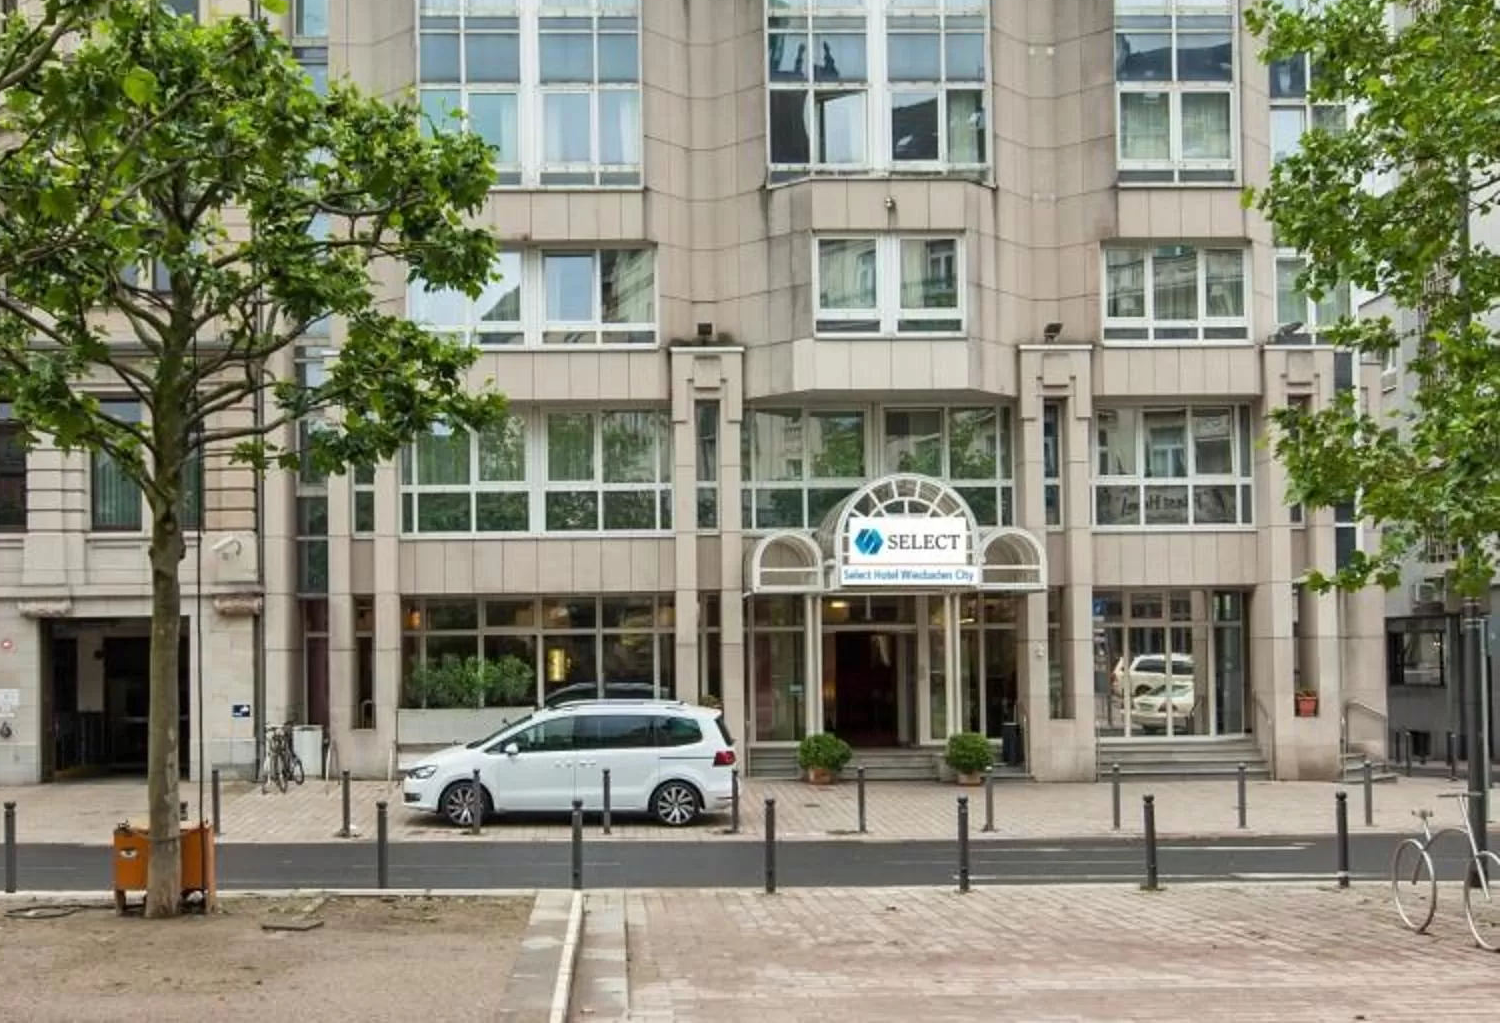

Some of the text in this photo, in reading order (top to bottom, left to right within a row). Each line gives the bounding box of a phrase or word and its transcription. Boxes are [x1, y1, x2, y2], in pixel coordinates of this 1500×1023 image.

[887, 534, 961, 550] SELECT
[843, 568, 974, 582] Select Hotel Wiesbaden City
